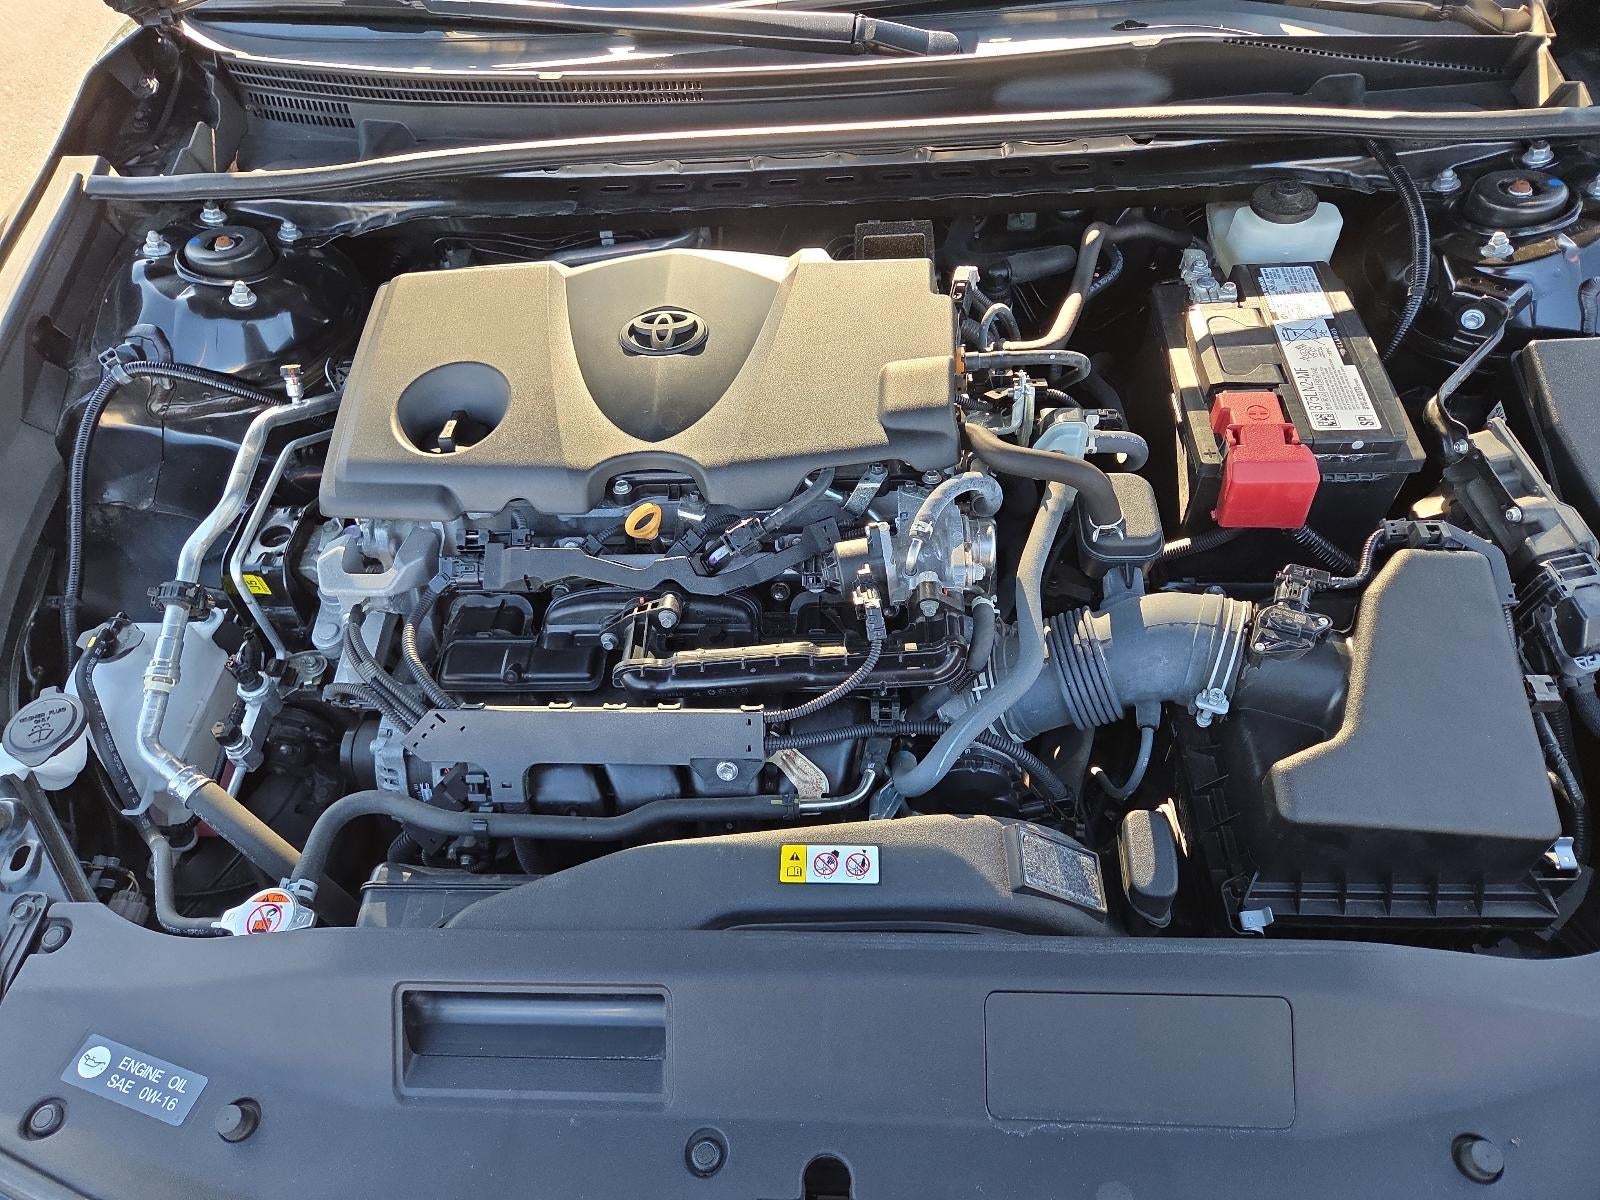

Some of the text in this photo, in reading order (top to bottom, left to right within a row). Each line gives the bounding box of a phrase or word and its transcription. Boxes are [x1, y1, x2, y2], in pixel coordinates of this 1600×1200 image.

[106, 1074, 179, 1111] SAE 0W-16
[118, 1056, 188, 1094] ENGINE OIL
